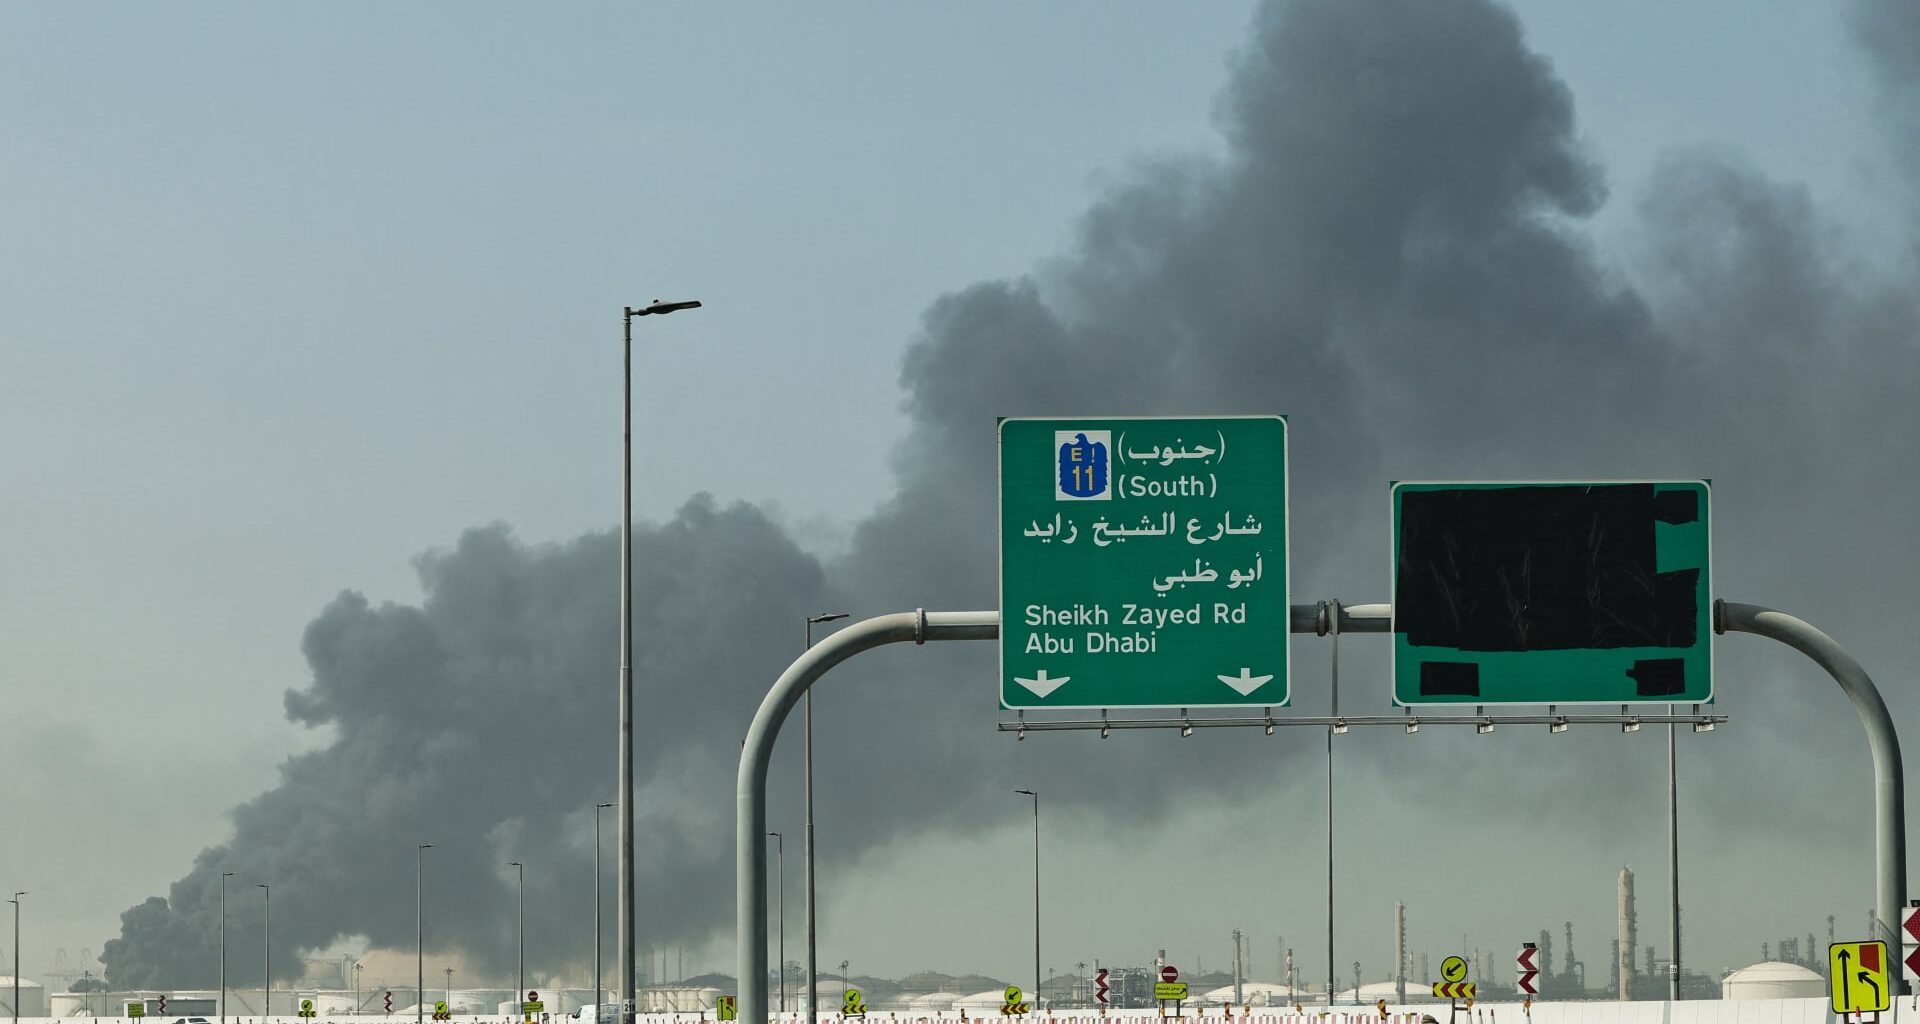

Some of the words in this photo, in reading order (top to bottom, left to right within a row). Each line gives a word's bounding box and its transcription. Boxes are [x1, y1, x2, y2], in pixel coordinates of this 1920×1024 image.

[1071, 447, 1083, 462] E
[1118, 430, 1226, 467] (جنوب)
[1072, 465, 1094, 491] 11
[1118, 473, 1217, 499] (South)
[1023, 512, 1078, 545] زايد
[1092, 510, 1176, 547] الشيخ
[1186, 510, 1262, 545] شارع
[1152, 558, 1219, 598] ظبي
[1226, 552, 1263, 589] أبو
[1024, 603, 1109, 626] Sheikh
[1122, 603, 1201, 629] Zayed
[1214, 602, 1246, 624] Rd
[1024, 632, 1074, 654] Abu
[1086, 631, 1156, 654] Dhabi
